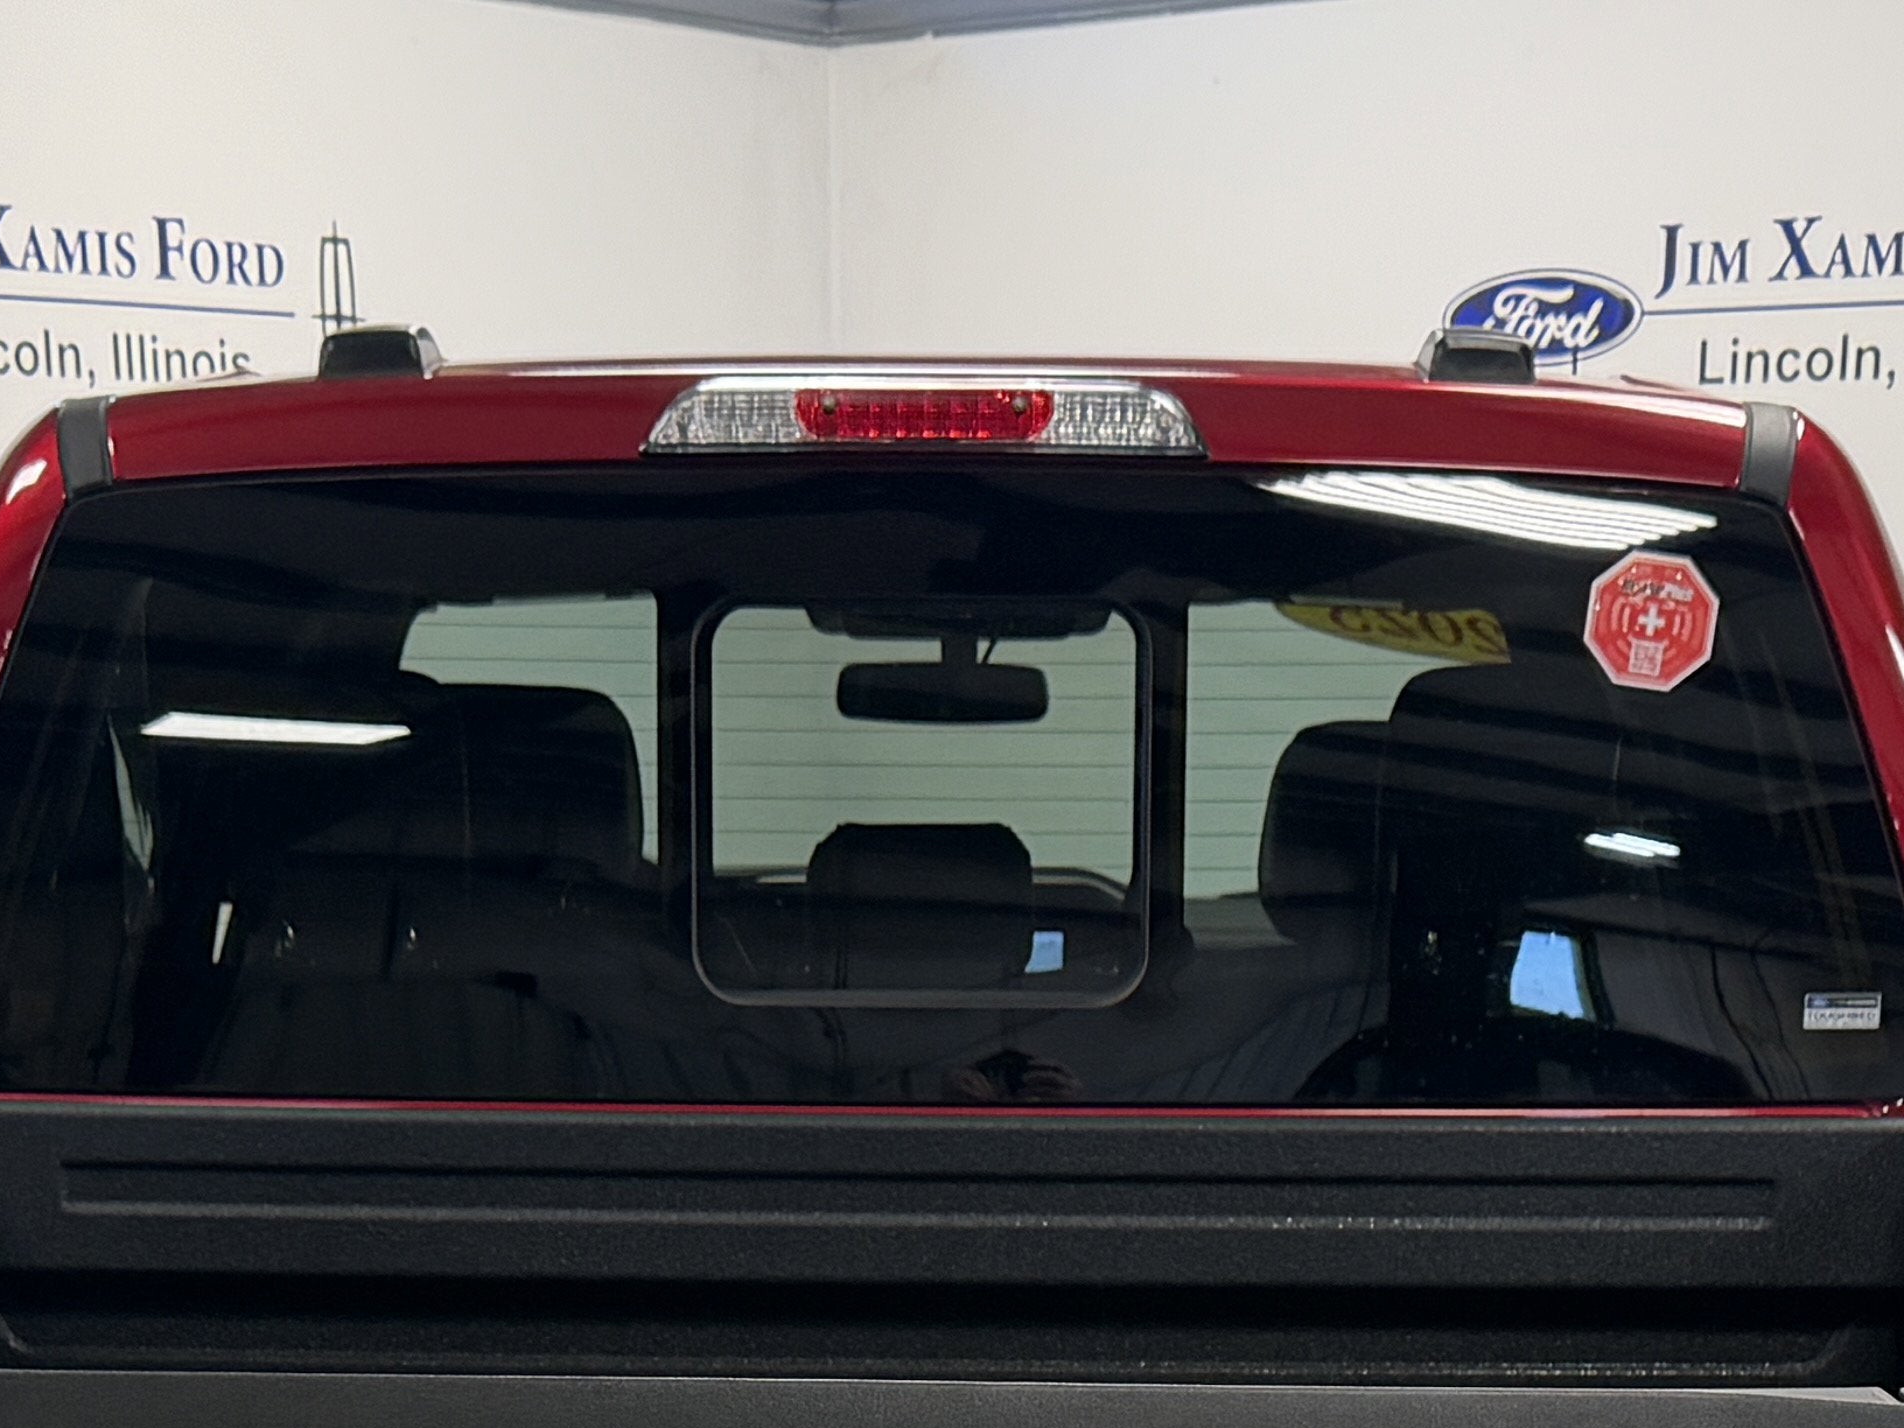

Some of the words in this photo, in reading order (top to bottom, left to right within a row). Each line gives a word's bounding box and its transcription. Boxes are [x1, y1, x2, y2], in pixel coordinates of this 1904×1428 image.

[153, 216, 284, 287] FORD
[1655, 223, 1749, 299] JIM
[1698, 334, 1896, 389] Lincoln,
